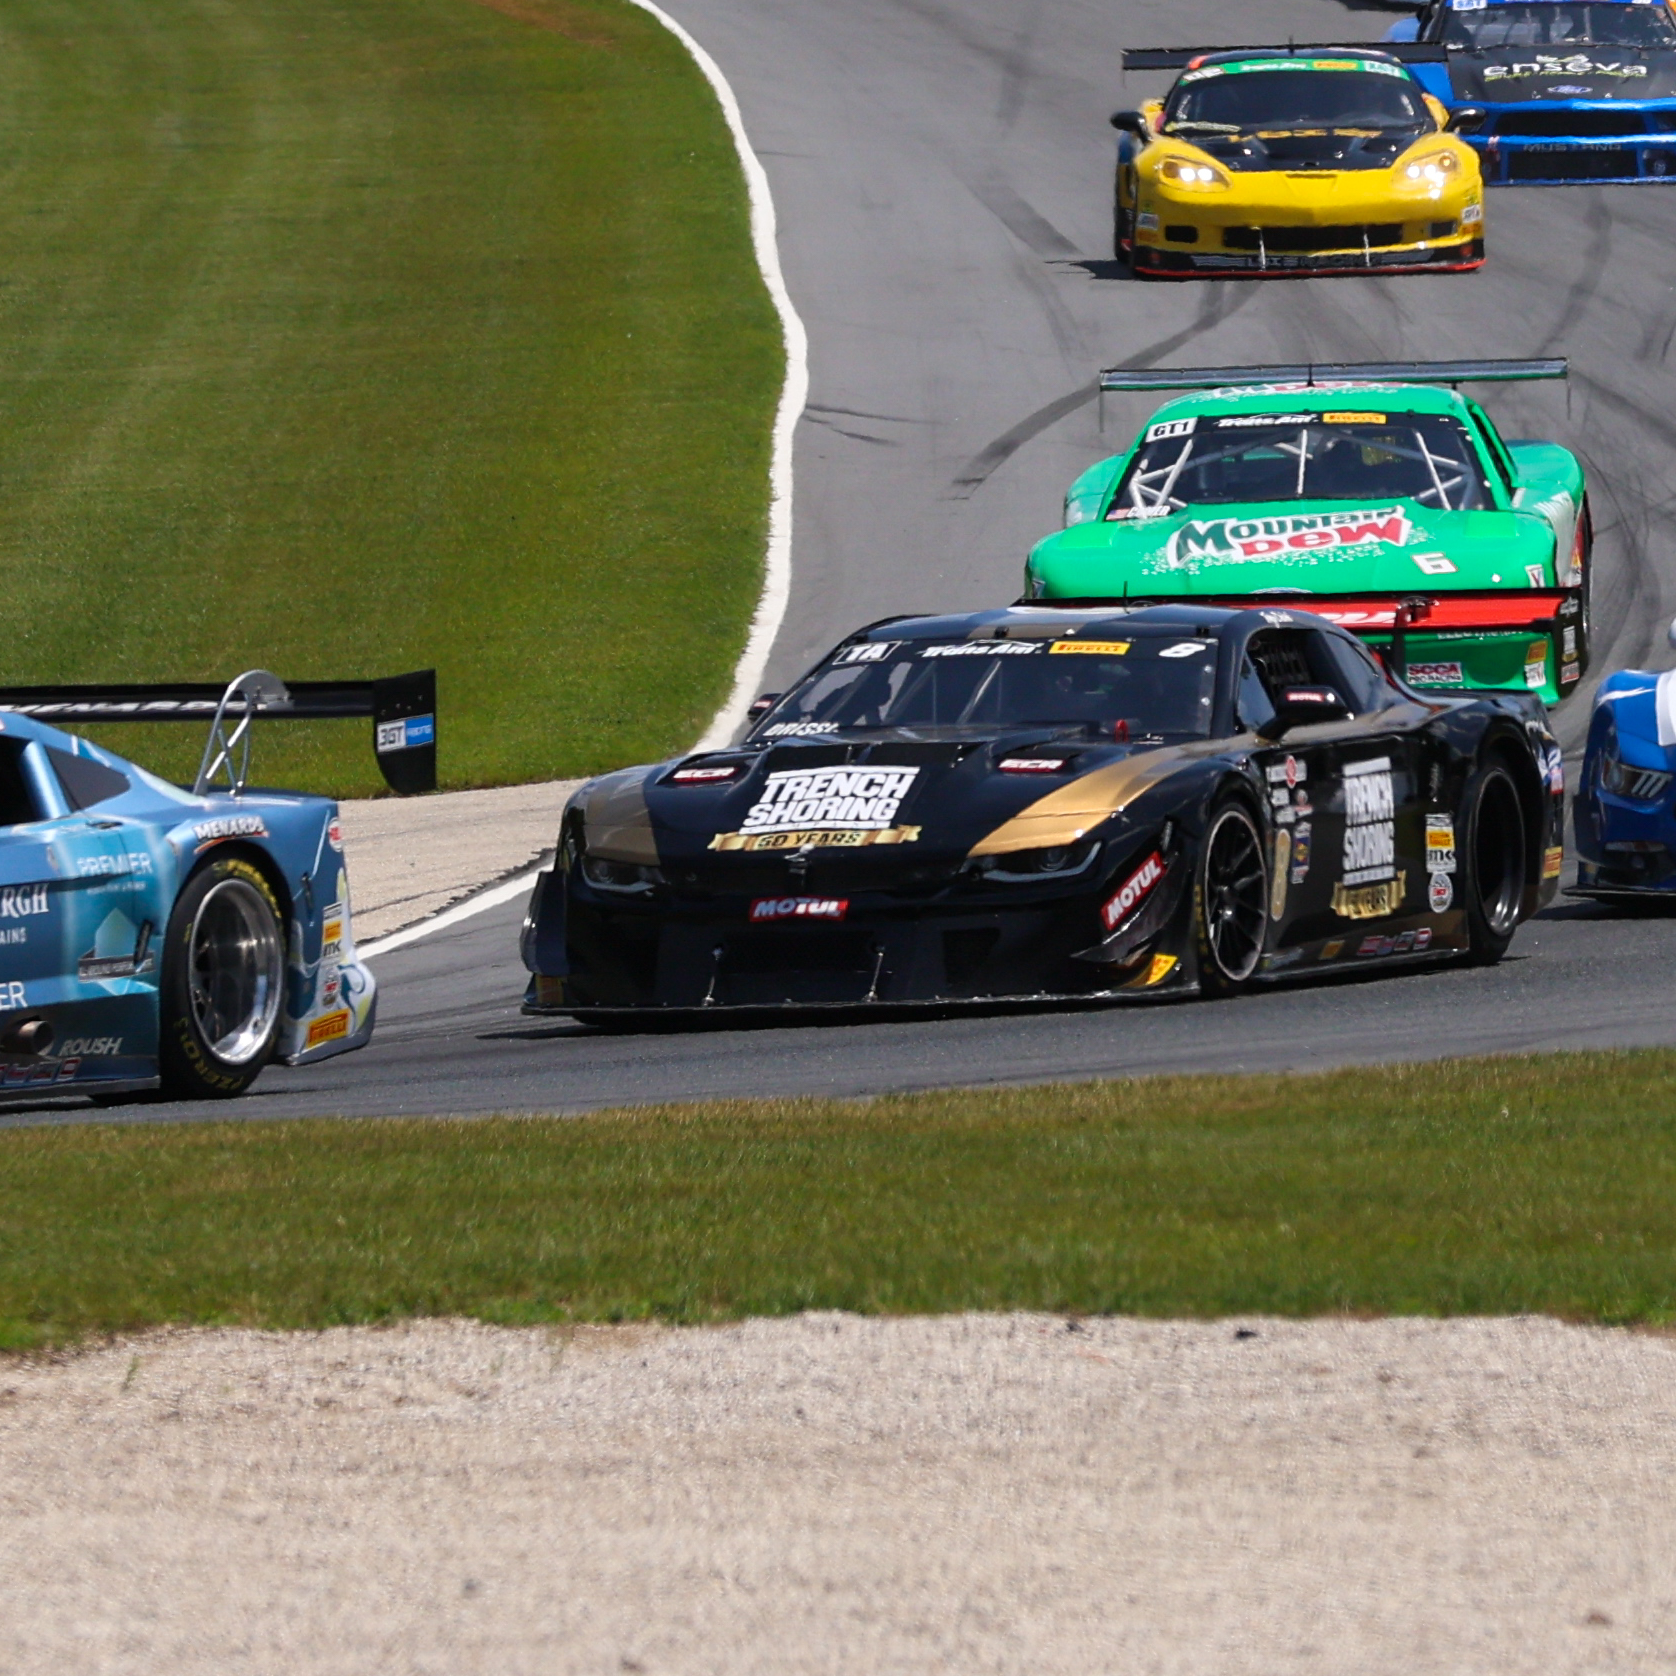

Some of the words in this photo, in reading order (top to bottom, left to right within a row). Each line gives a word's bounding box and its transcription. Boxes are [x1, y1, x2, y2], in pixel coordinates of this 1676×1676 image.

[1151, 420, 1194, 439] GT1
[1218, 416, 1273, 427] Trans
[1414, 552, 1459, 575] 6
[846, 643, 883, 661] TA
[921, 644, 988, 658] Trans
[1057, 642, 1123, 654] PIRELLI
[1159, 643, 1207, 659] 8
[1408, 664, 1459, 675] SCCA
[378, 726, 405, 747] 3GT
[673, 767, 736, 779] ECR
[999, 757, 1065, 771] ECR
[760, 772, 916, 804] TRENCH
[742, 797, 901, 827] SHORING
[193, 815, 266, 840] MENARDS
[757, 833, 789, 848] 50
[793, 831, 861, 847] YEARS
[77, 852, 154, 875] PREMIER
[1107, 858, 1163, 926] MOTUL
[753, 898, 842, 918] MOTUL
[309, 1013, 348, 1042] PIRELLI
[59, 1037, 124, 1057] ROUSH
